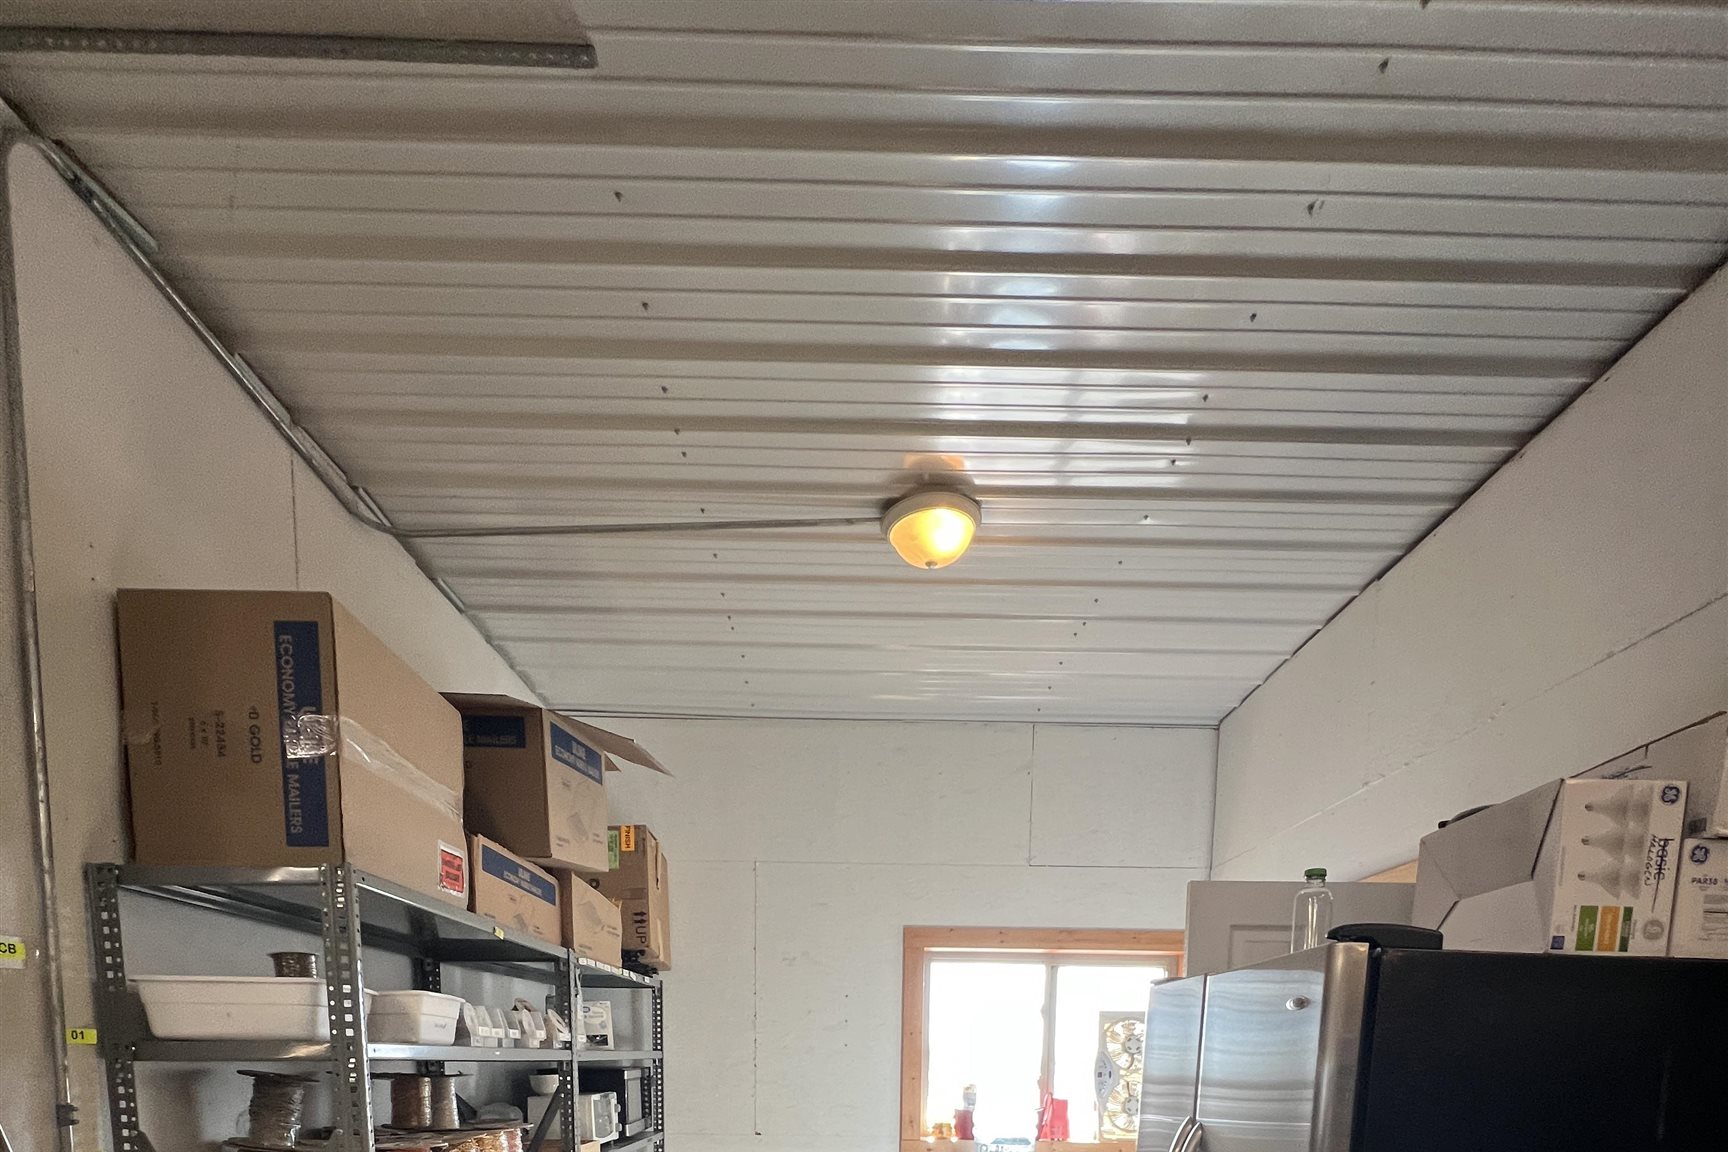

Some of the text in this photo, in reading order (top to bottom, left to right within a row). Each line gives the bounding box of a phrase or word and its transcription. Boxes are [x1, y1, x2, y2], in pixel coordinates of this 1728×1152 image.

[278, 634, 295, 714] ECONOMY
[249, 724, 263, 764] GOLD
[288, 774, 304, 834] MAILERS
[635, 925, 648, 944] UP
[71, 1030, 85, 1041] 01
